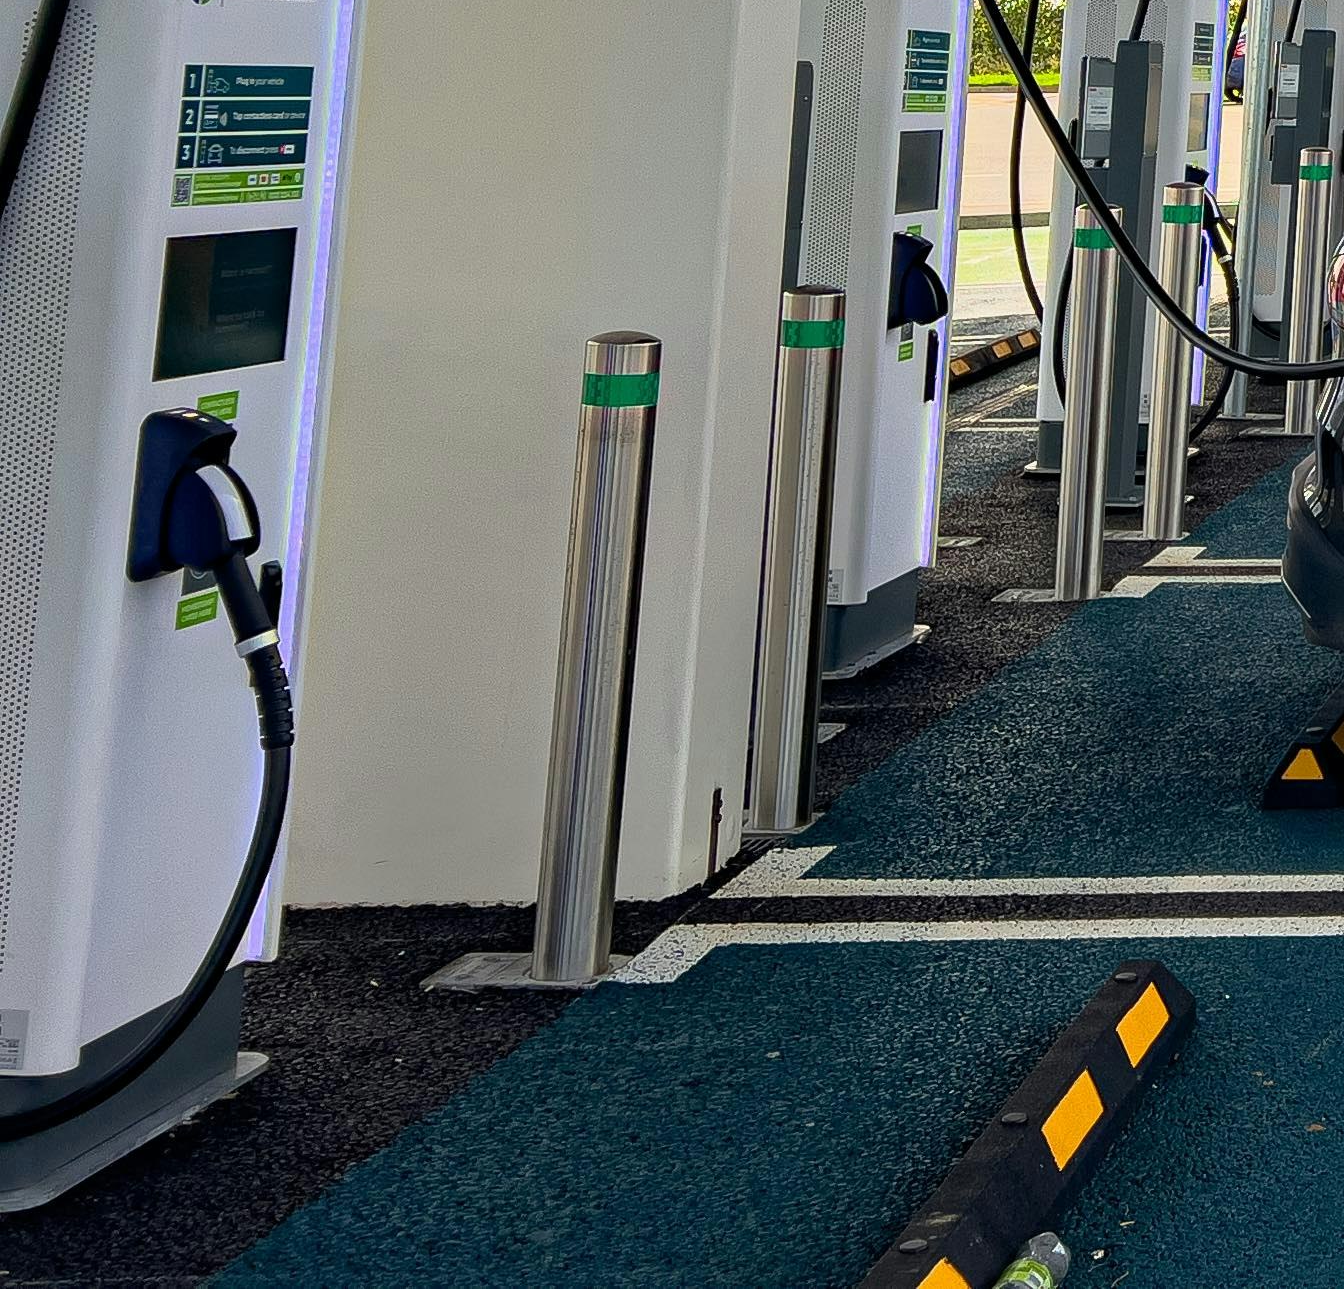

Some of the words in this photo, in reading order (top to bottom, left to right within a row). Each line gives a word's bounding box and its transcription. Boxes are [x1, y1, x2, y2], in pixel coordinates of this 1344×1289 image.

[189, 73, 196, 89] 1
[184, 108, 194, 125] 2
[181, 144, 191, 161] 3
